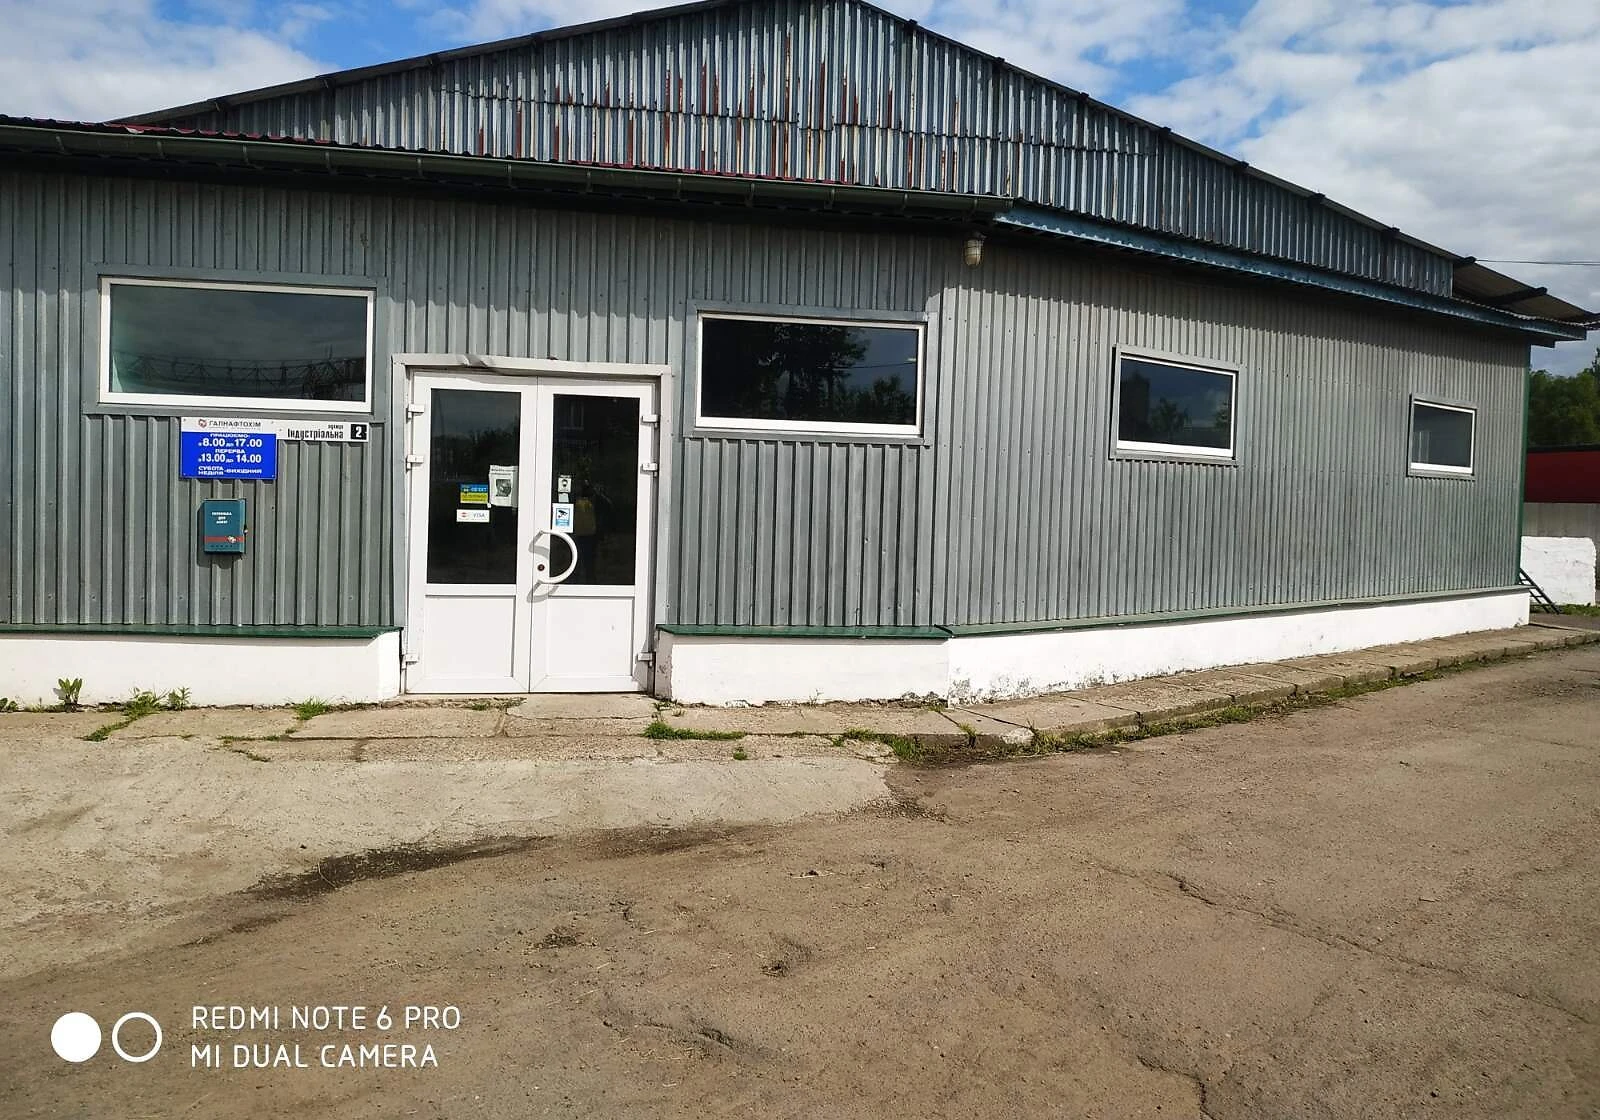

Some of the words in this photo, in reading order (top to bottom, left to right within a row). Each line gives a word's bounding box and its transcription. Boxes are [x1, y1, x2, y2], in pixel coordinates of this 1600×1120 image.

[287, 428, 344, 441] Індустріальна
[355, 425, 362, 438] 2
[202, 438, 225, 447] 8.00
[234, 438, 263, 448] 17.00
[201, 453, 226, 463] 13.00
[236, 454, 262, 463] 14.00
